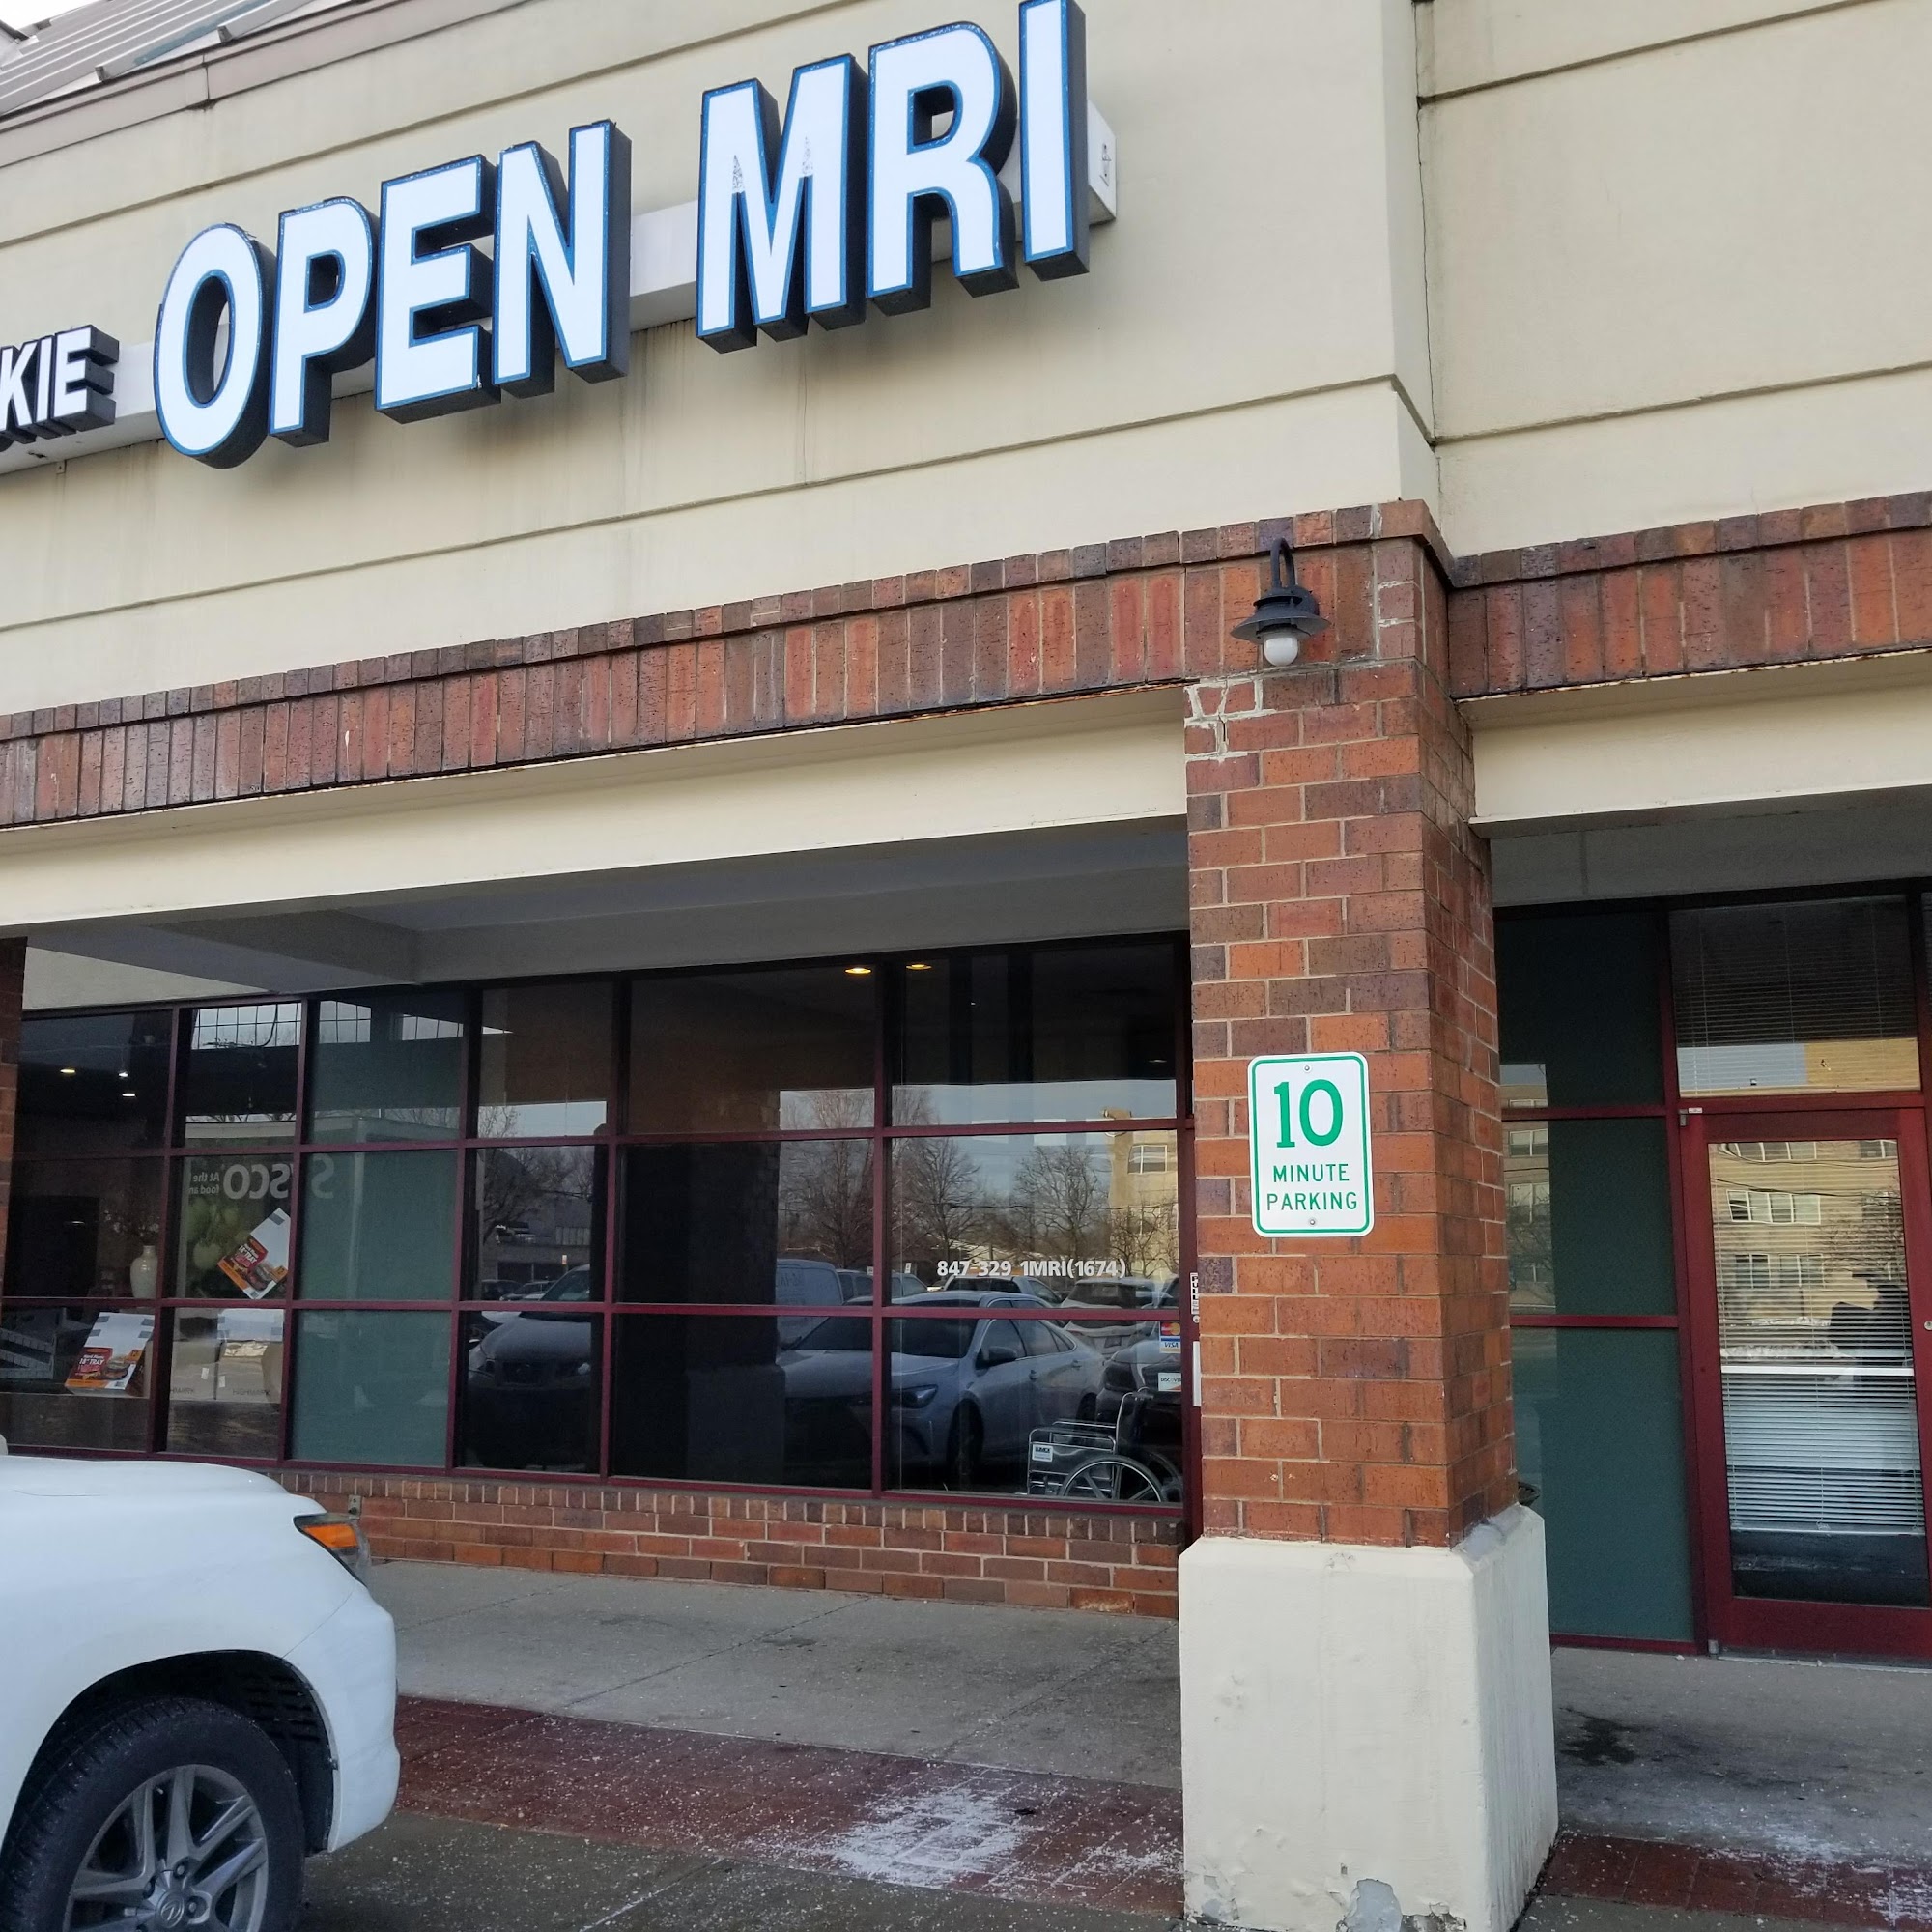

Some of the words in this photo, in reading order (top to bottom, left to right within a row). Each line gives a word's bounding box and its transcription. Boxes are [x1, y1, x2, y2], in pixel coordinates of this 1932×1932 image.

[0, 326, 92, 431] KIE
[154, 120, 615, 459] OPEN
[696, 0, 1075, 338] MRI
[1273, 1078, 1344, 1148] 10
[1272, 1163, 1350, 1182] MINUTE
[1266, 1191, 1357, 1210] PARKING
[936, 1260, 1012, 1276] 847-329
[1019, 1258, 1126, 1278] 1MRI(1674)
